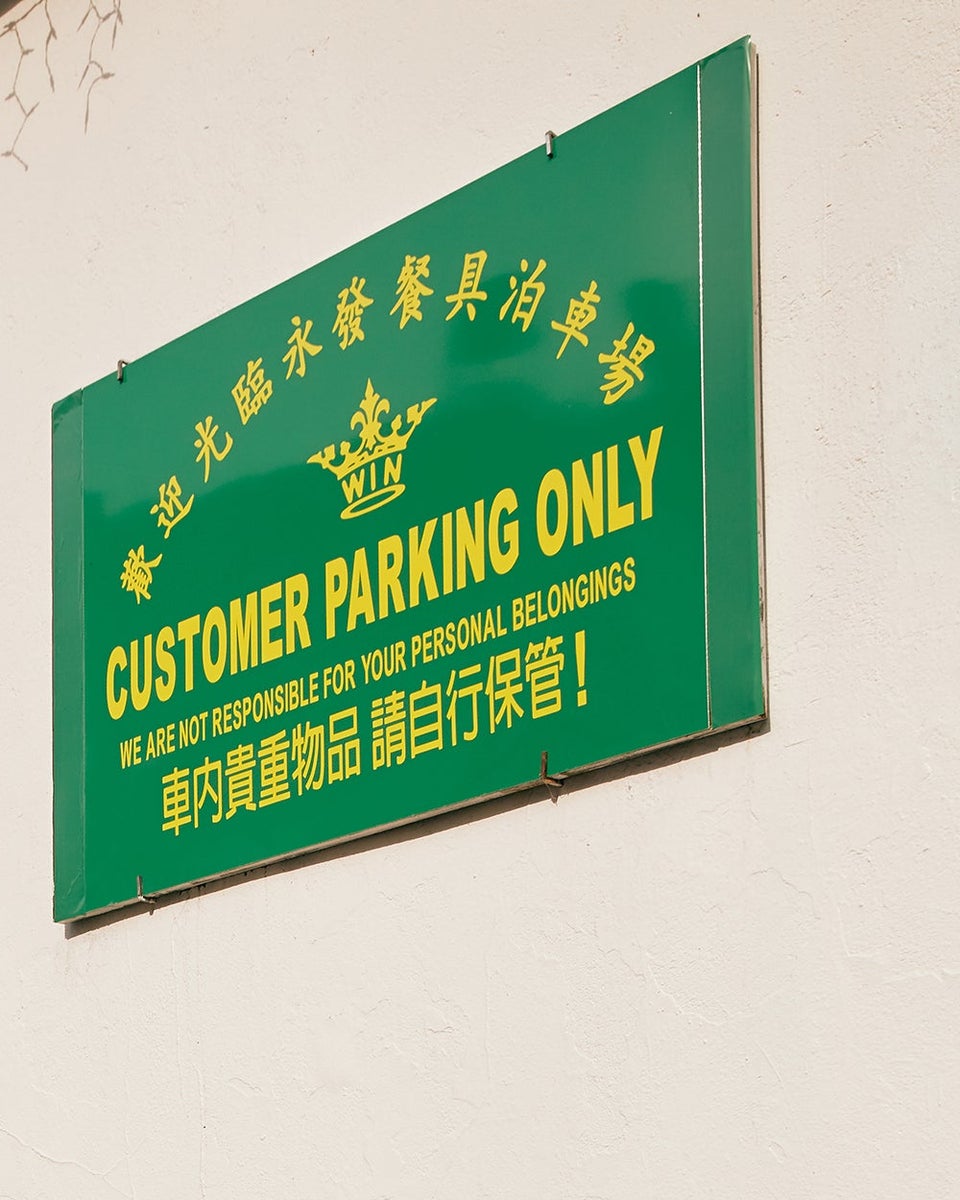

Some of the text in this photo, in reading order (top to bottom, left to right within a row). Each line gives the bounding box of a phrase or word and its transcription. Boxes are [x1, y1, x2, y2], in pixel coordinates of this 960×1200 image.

[106, 426, 663, 720] CUSTOMER PARKING ONLY
[341, 454, 403, 504] WIN
[120, 557, 636, 768] WE ARE NOT RESPONSIBLE FOR YOUR PERSONAL BELONGINGS
